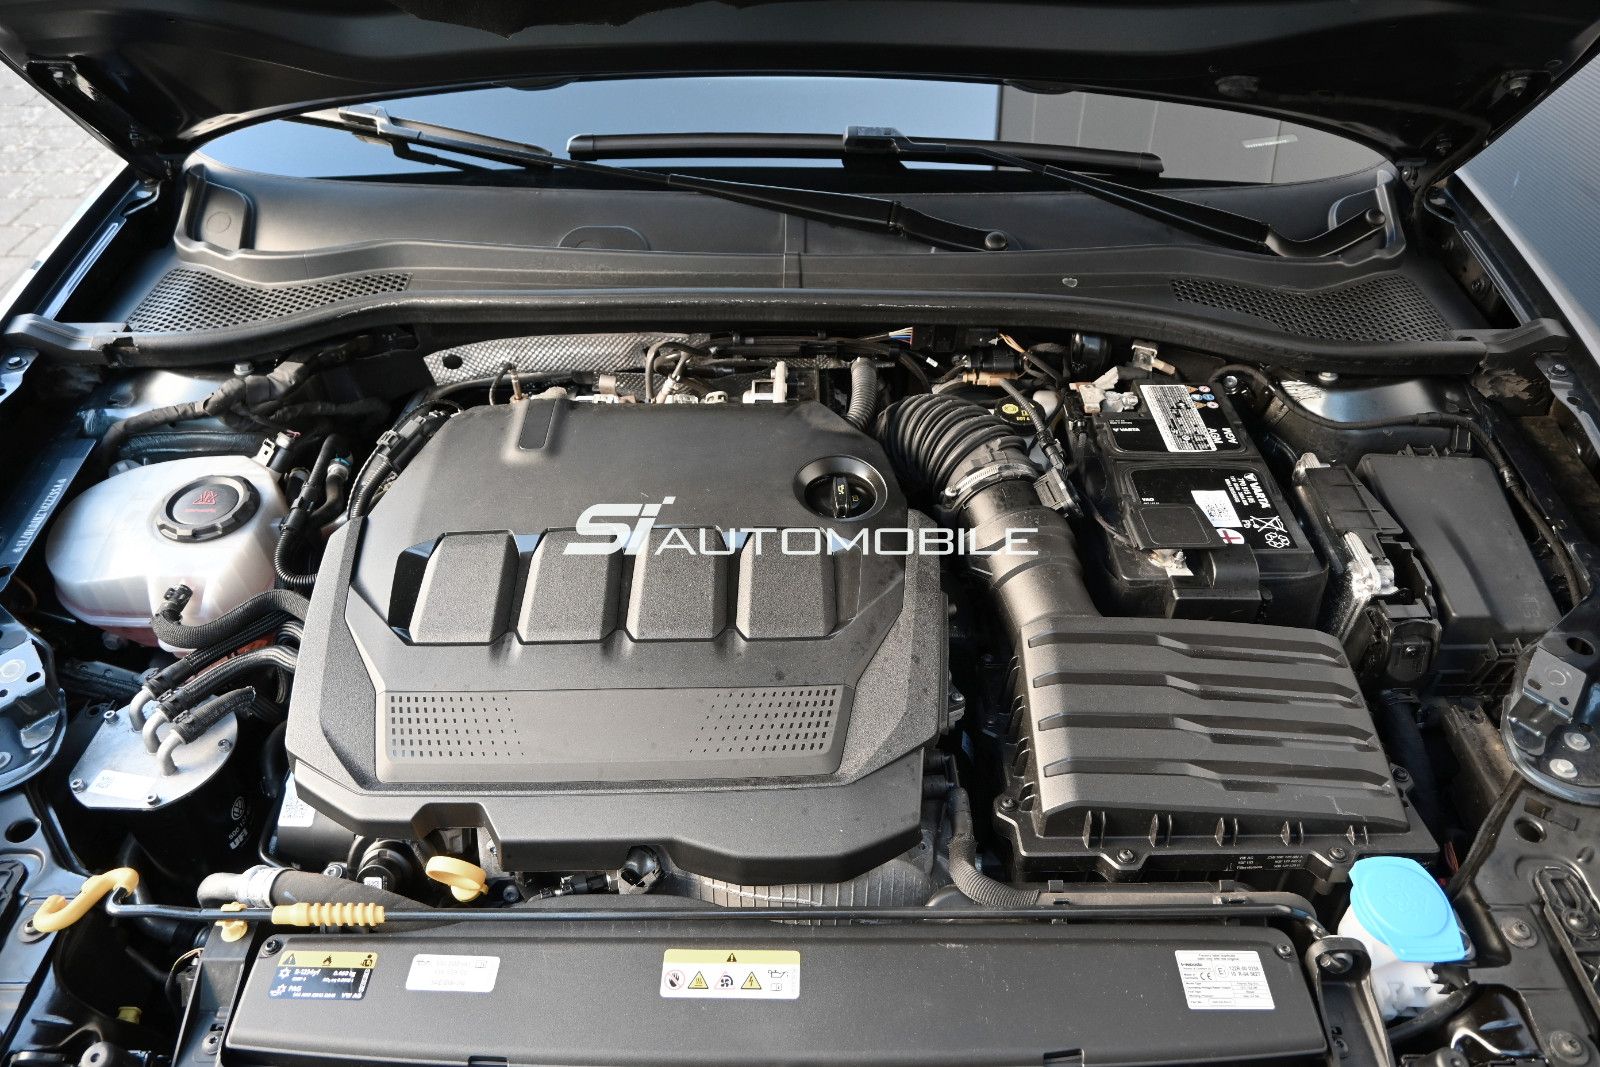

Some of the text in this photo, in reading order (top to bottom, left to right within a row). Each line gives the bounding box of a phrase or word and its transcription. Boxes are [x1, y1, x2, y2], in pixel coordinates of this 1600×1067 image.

[1207, 427, 1223, 444] AGM
[1222, 427, 1239, 444] AGM
[1250, 482, 1271, 508] VARTA
